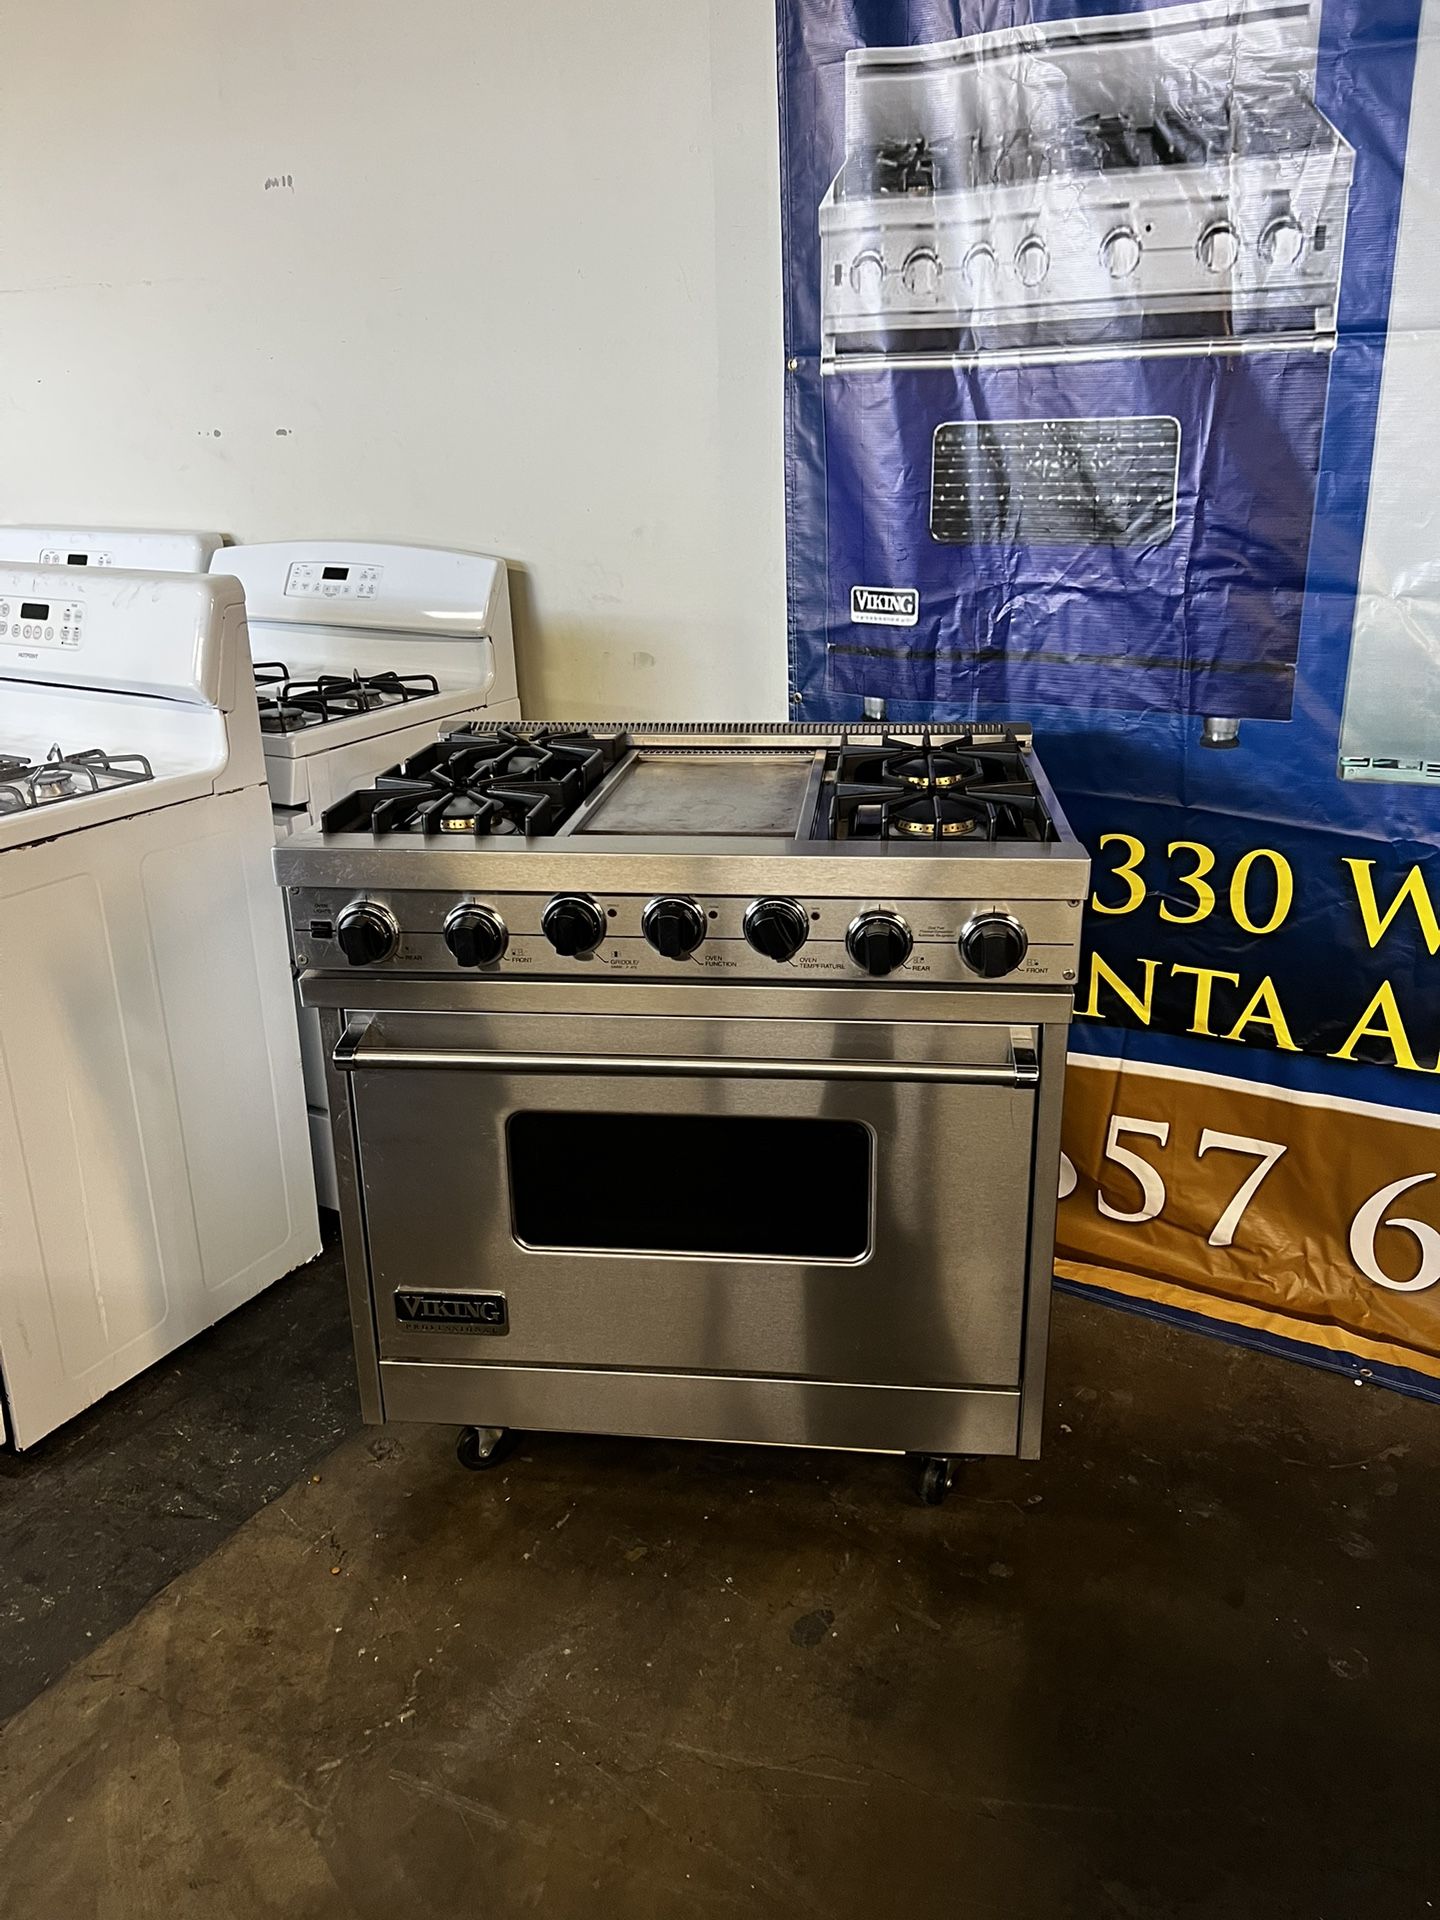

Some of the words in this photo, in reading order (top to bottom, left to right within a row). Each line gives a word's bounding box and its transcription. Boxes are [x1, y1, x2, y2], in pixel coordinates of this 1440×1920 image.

[855, 590, 913, 613] VIKING
[1091, 832, 1293, 935] 330
[1341, 857, 1440, 955] W
[1072, 951, 1303, 1051] NTA
[1326, 980, 1440, 1073] A
[1057, 1114, 1288, 1246] 57
[1349, 1172, 1440, 1292] 6
[400, 1296, 501, 1321] VIKING
